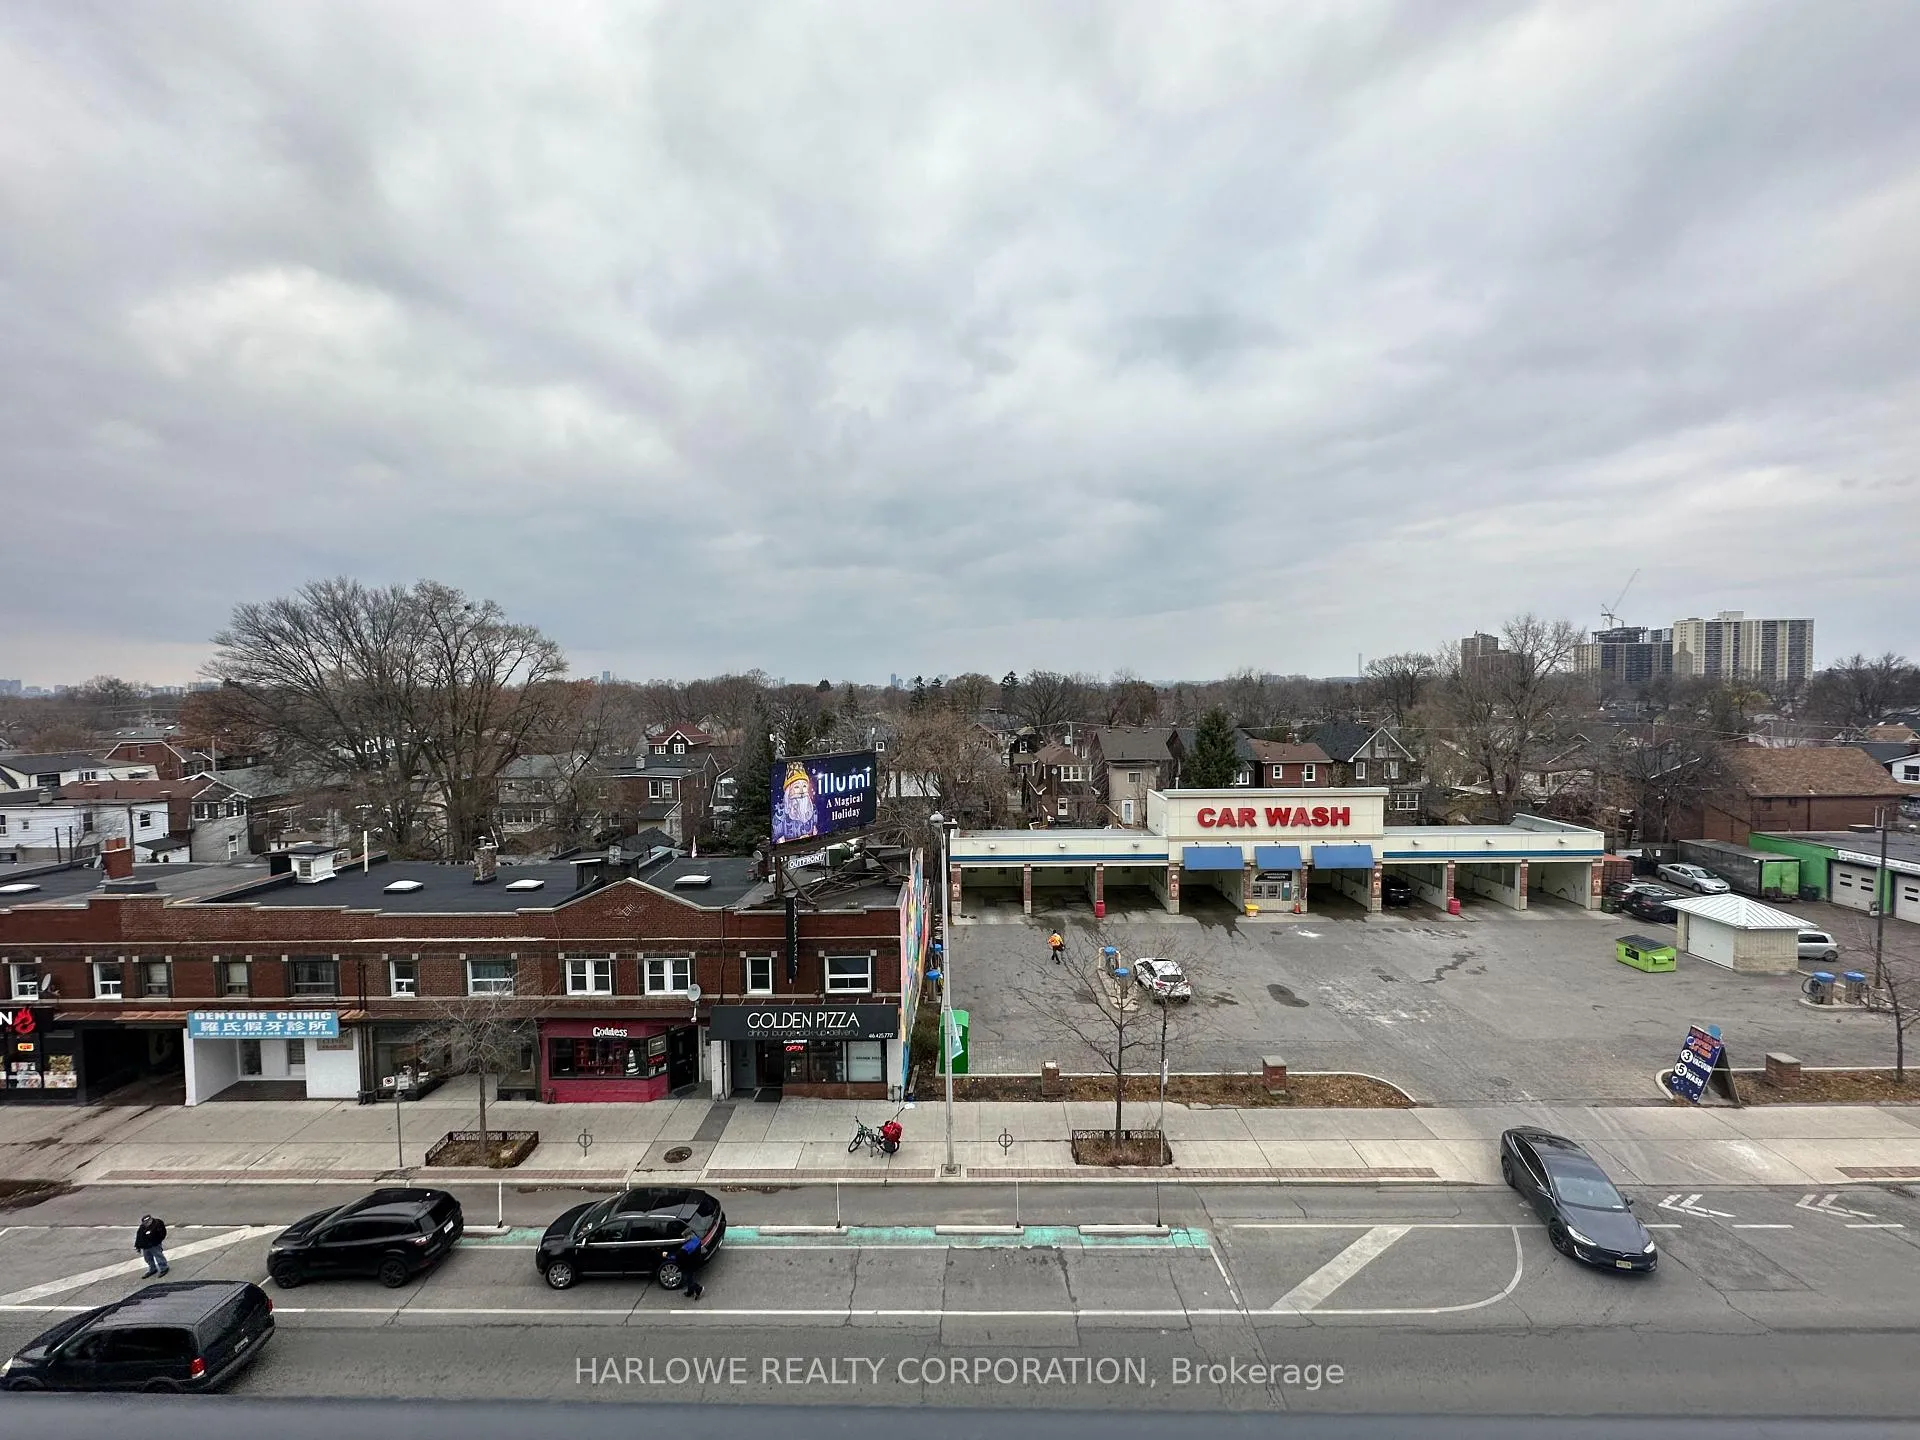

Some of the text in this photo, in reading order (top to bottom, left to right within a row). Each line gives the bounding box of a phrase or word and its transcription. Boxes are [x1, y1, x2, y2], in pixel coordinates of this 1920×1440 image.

[817, 766, 871, 795] illumi
[826, 793, 863, 808] A Magical
[832, 808, 861, 821] Holiday
[1197, 806, 1350, 828] CAR WASH
[789, 853, 824, 869] OUTFRONT
[194, 1012, 332, 1020] DENTURE CLINIC
[747, 1011, 860, 1028] GOLDEN PIZZA
[592, 1026, 628, 1037] Goddess
[1692, 1056, 1713, 1073] VACUUM
[1685, 1071, 1704, 1087] WASH
